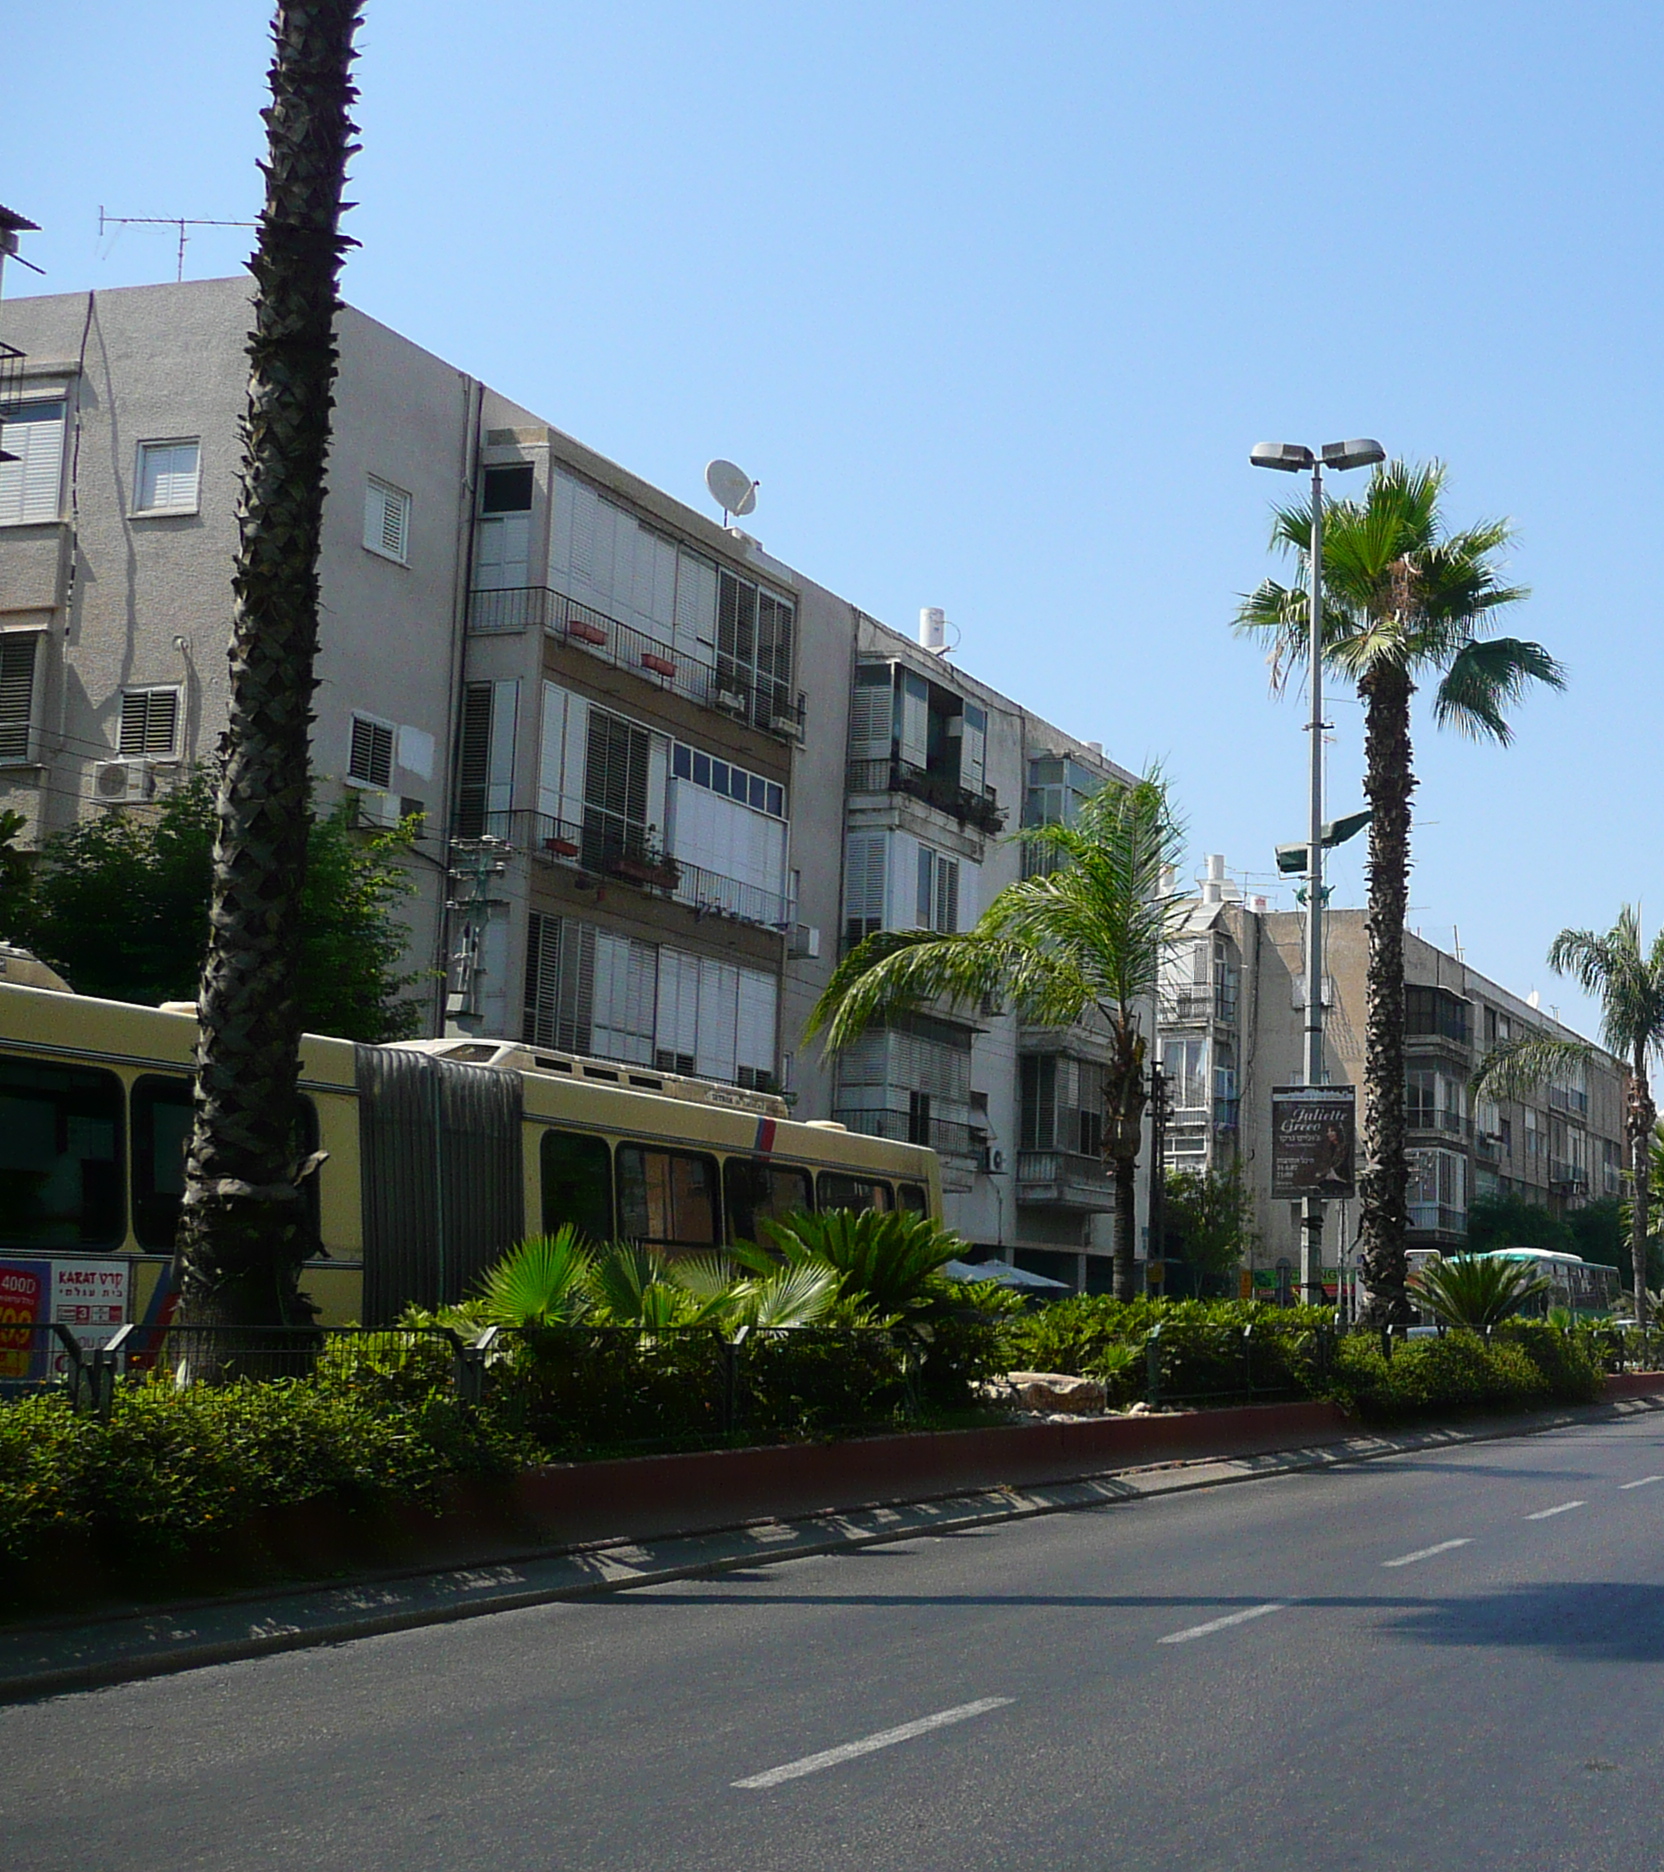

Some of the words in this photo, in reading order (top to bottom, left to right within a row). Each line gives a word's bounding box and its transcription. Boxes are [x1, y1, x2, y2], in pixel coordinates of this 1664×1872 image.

[1293, 1108, 1347, 1122] Juliette
[1281, 1119, 1321, 1134] Greco
[2, 1275, 36, 1294] 400D
[58, 1271, 97, 1285] KARAT
[98, 1272, 123, 1289] קרט
